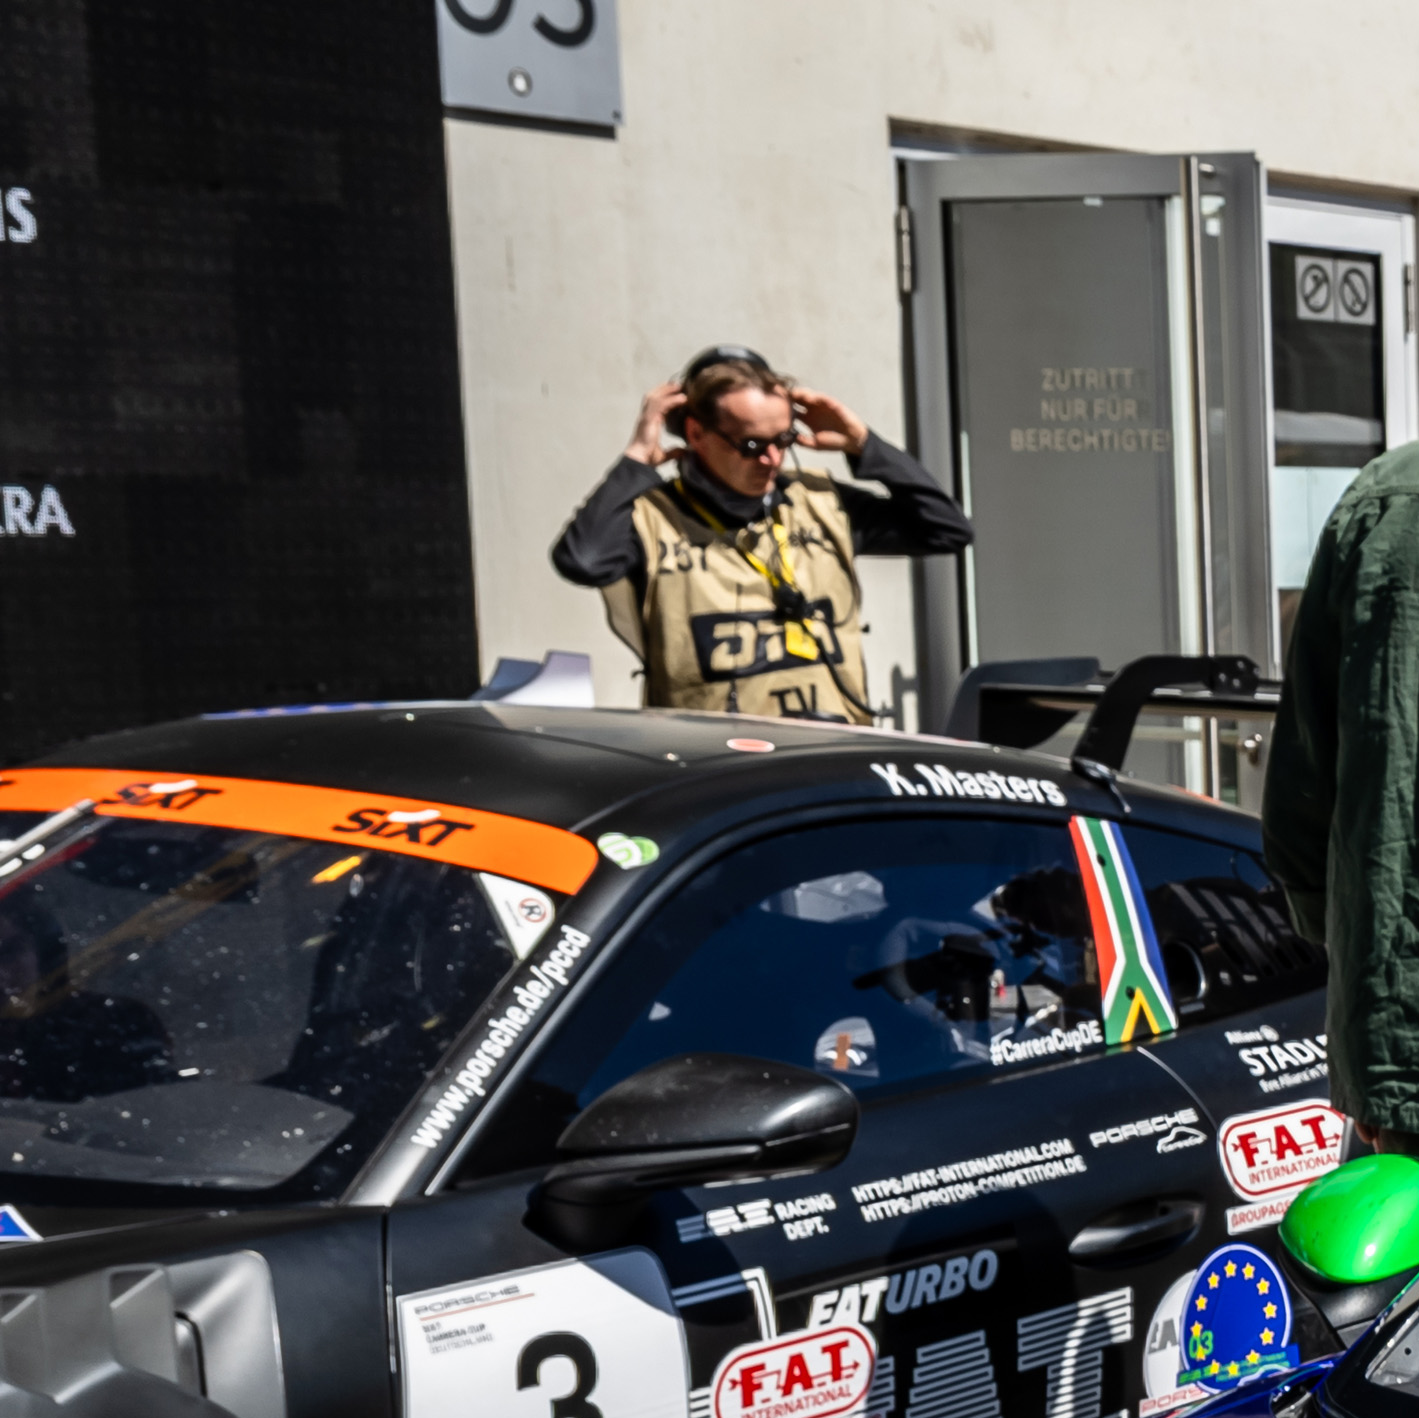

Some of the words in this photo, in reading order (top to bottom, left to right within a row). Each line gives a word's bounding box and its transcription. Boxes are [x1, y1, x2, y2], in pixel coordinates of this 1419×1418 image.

[1041, 367, 1134, 391] ZUTRITT
[1041, 399, 1086, 421] NUR
[1093, 397, 1138, 421] FÜR
[411, 925, 591, 1149] www.porsche.de/pccd
[1089, 1107, 1199, 1148] PORSCHE
[1249, 1152, 1340, 1184] INTERNATIONAL
[775, 1192, 837, 1221] RACING
[784, 1216, 830, 1241] DEPT.
